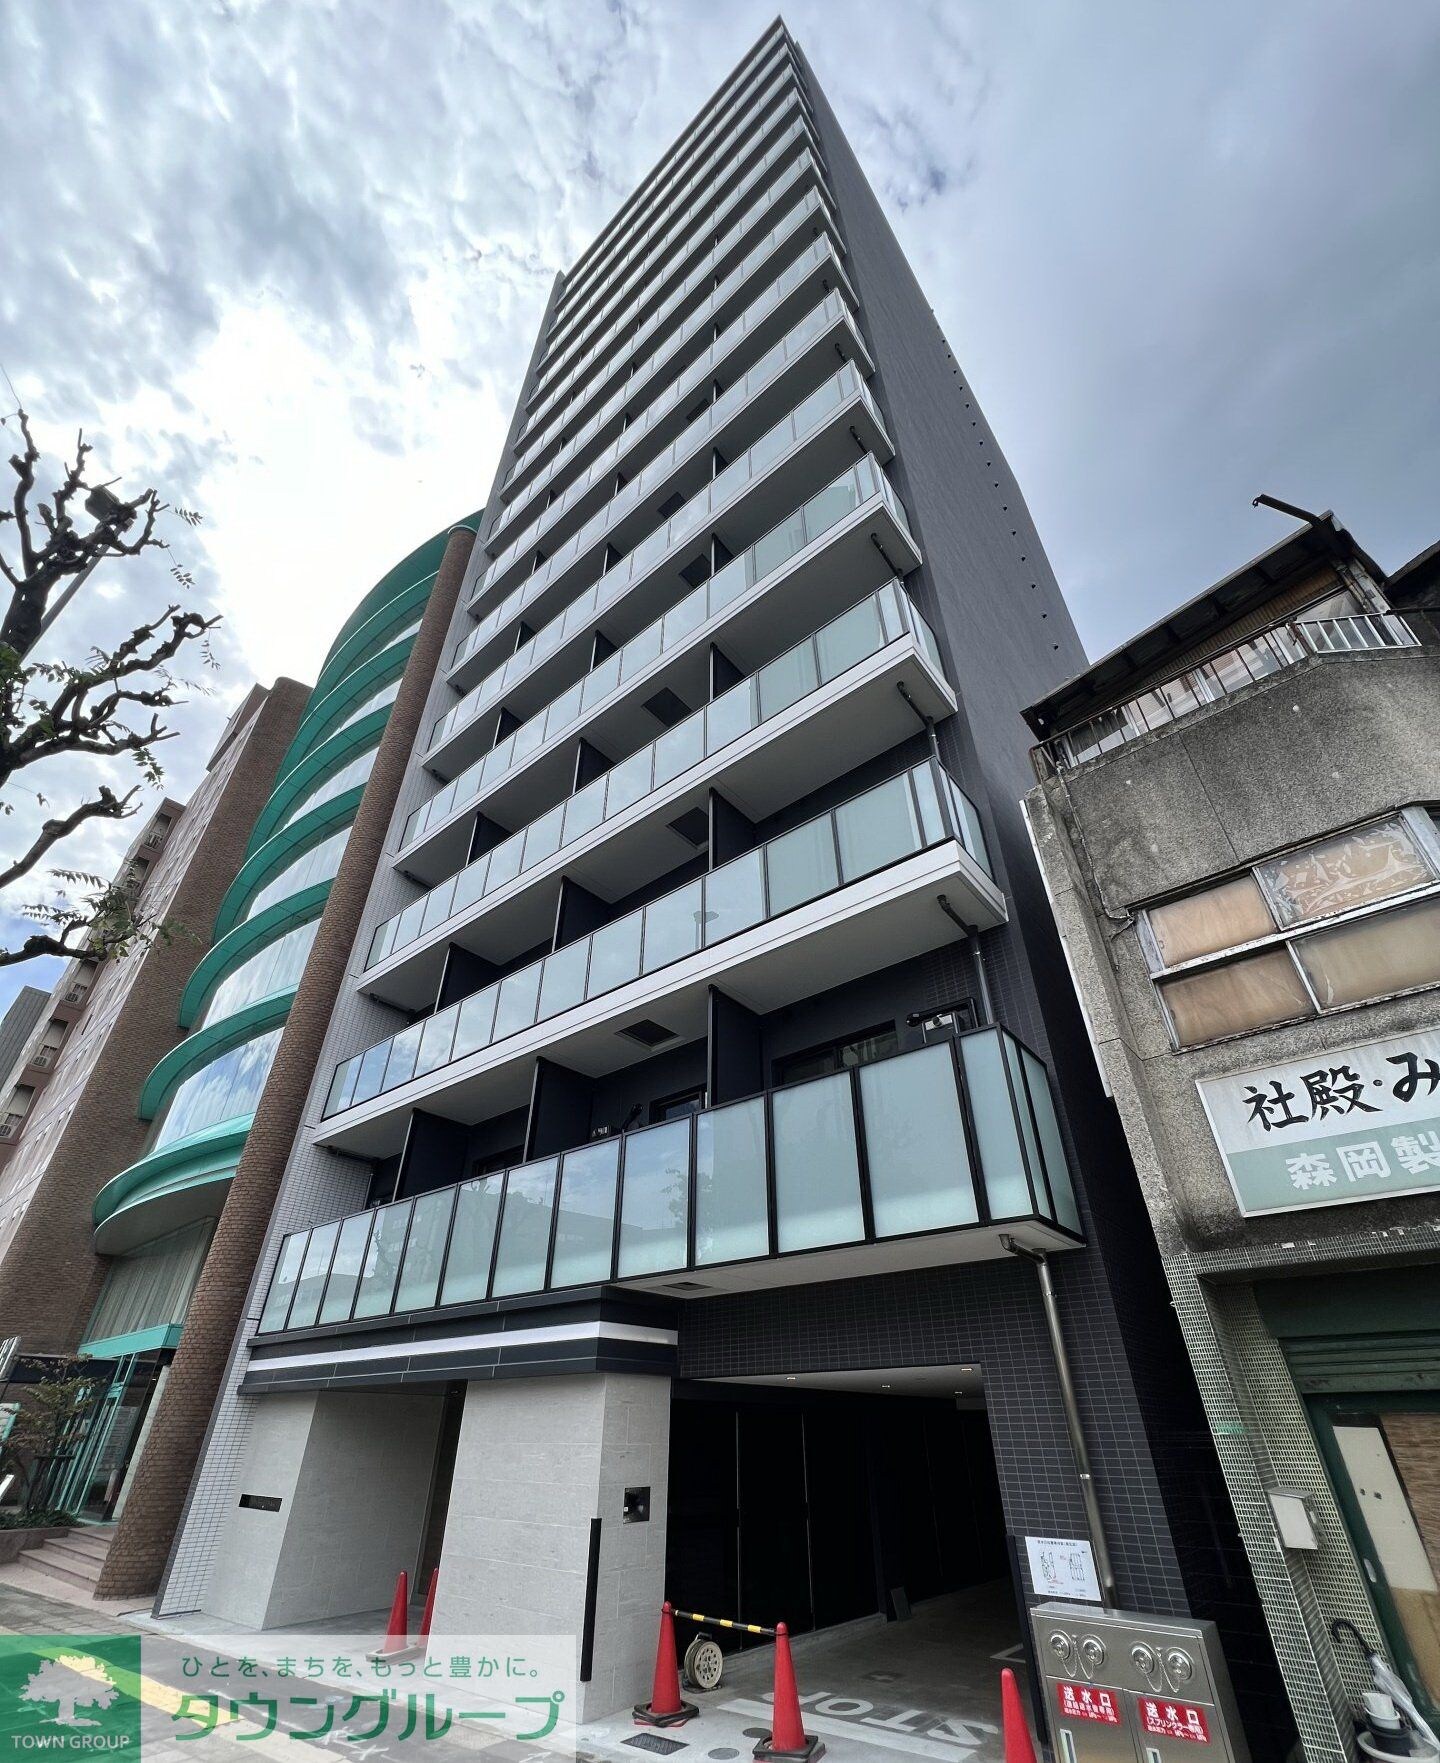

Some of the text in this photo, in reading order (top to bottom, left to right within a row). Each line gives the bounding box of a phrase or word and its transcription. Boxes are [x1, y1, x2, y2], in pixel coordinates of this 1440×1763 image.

[1285, 1130, 1440, 1190] 森岡製
[1063, 1685, 1111, 1708] 送水口
[1145, 1700, 1200, 1726] 送水口
